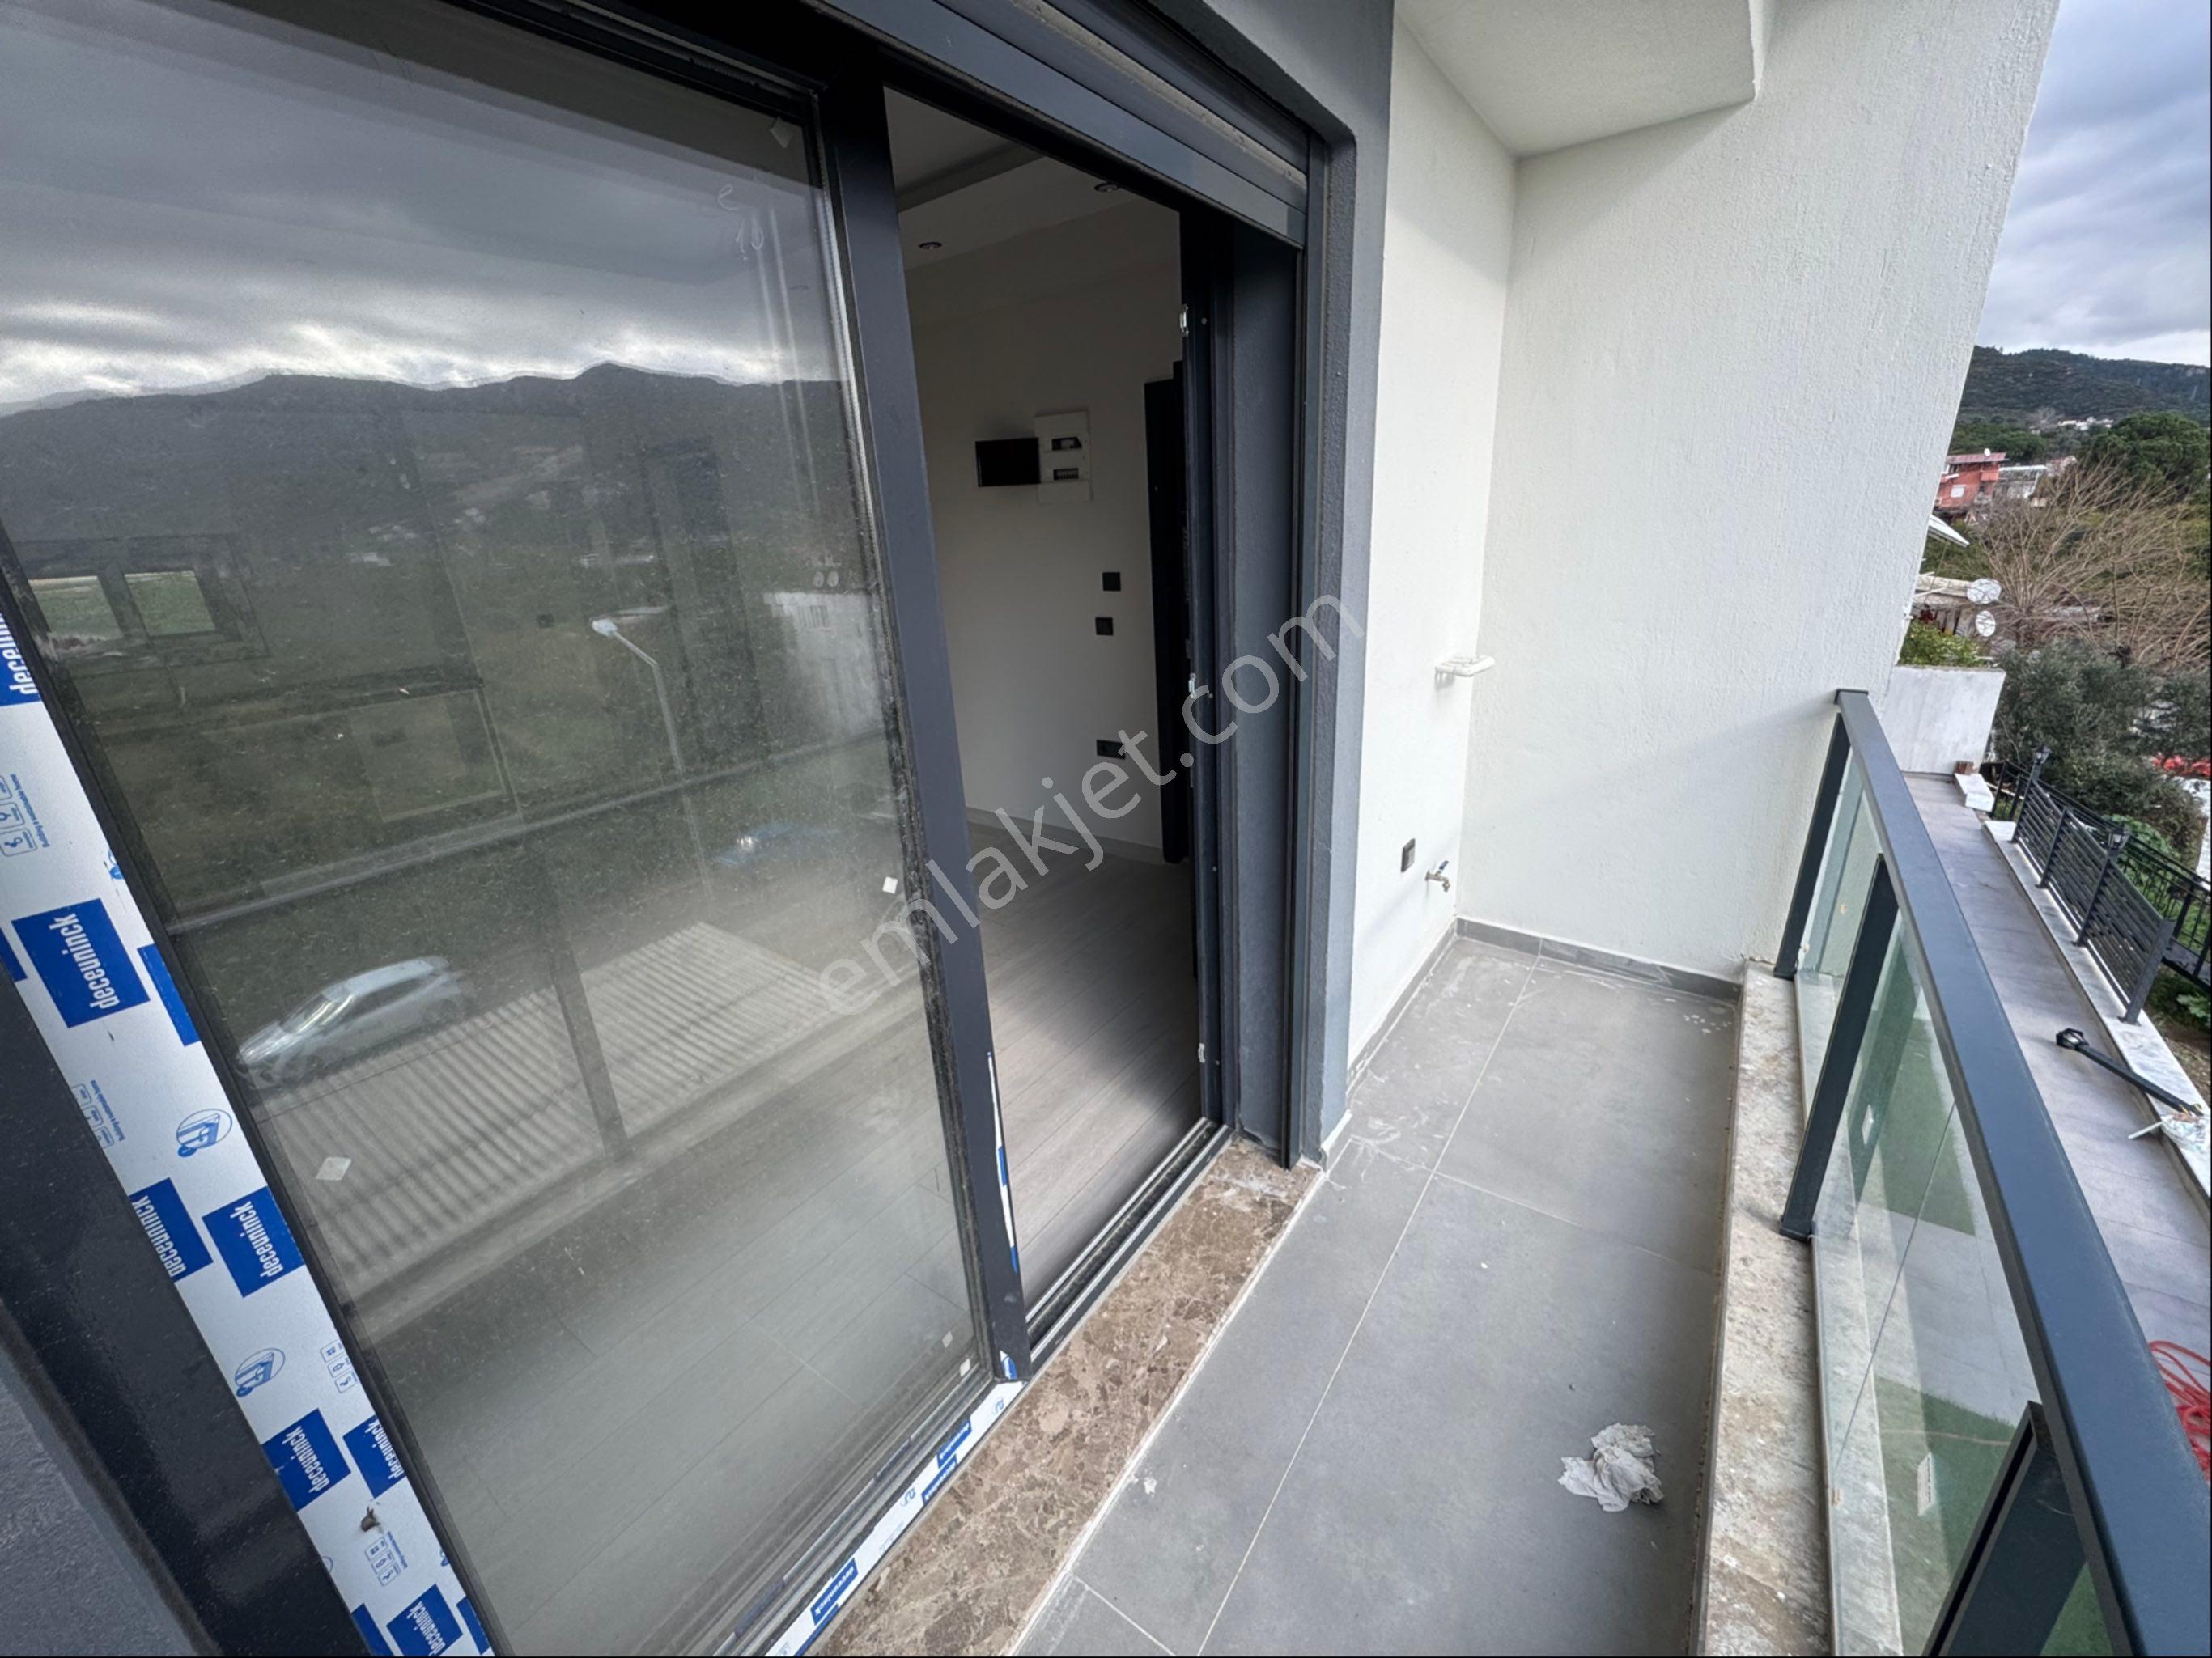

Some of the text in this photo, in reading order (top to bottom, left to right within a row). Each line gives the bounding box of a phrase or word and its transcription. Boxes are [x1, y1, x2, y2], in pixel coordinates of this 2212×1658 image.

[49, 913, 121, 1009] deceuninck
[230, 1201, 284, 1278] deceuninck
[282, 1426, 330, 1494] deceuninck
[406, 1601, 446, 1656] deceuninck
